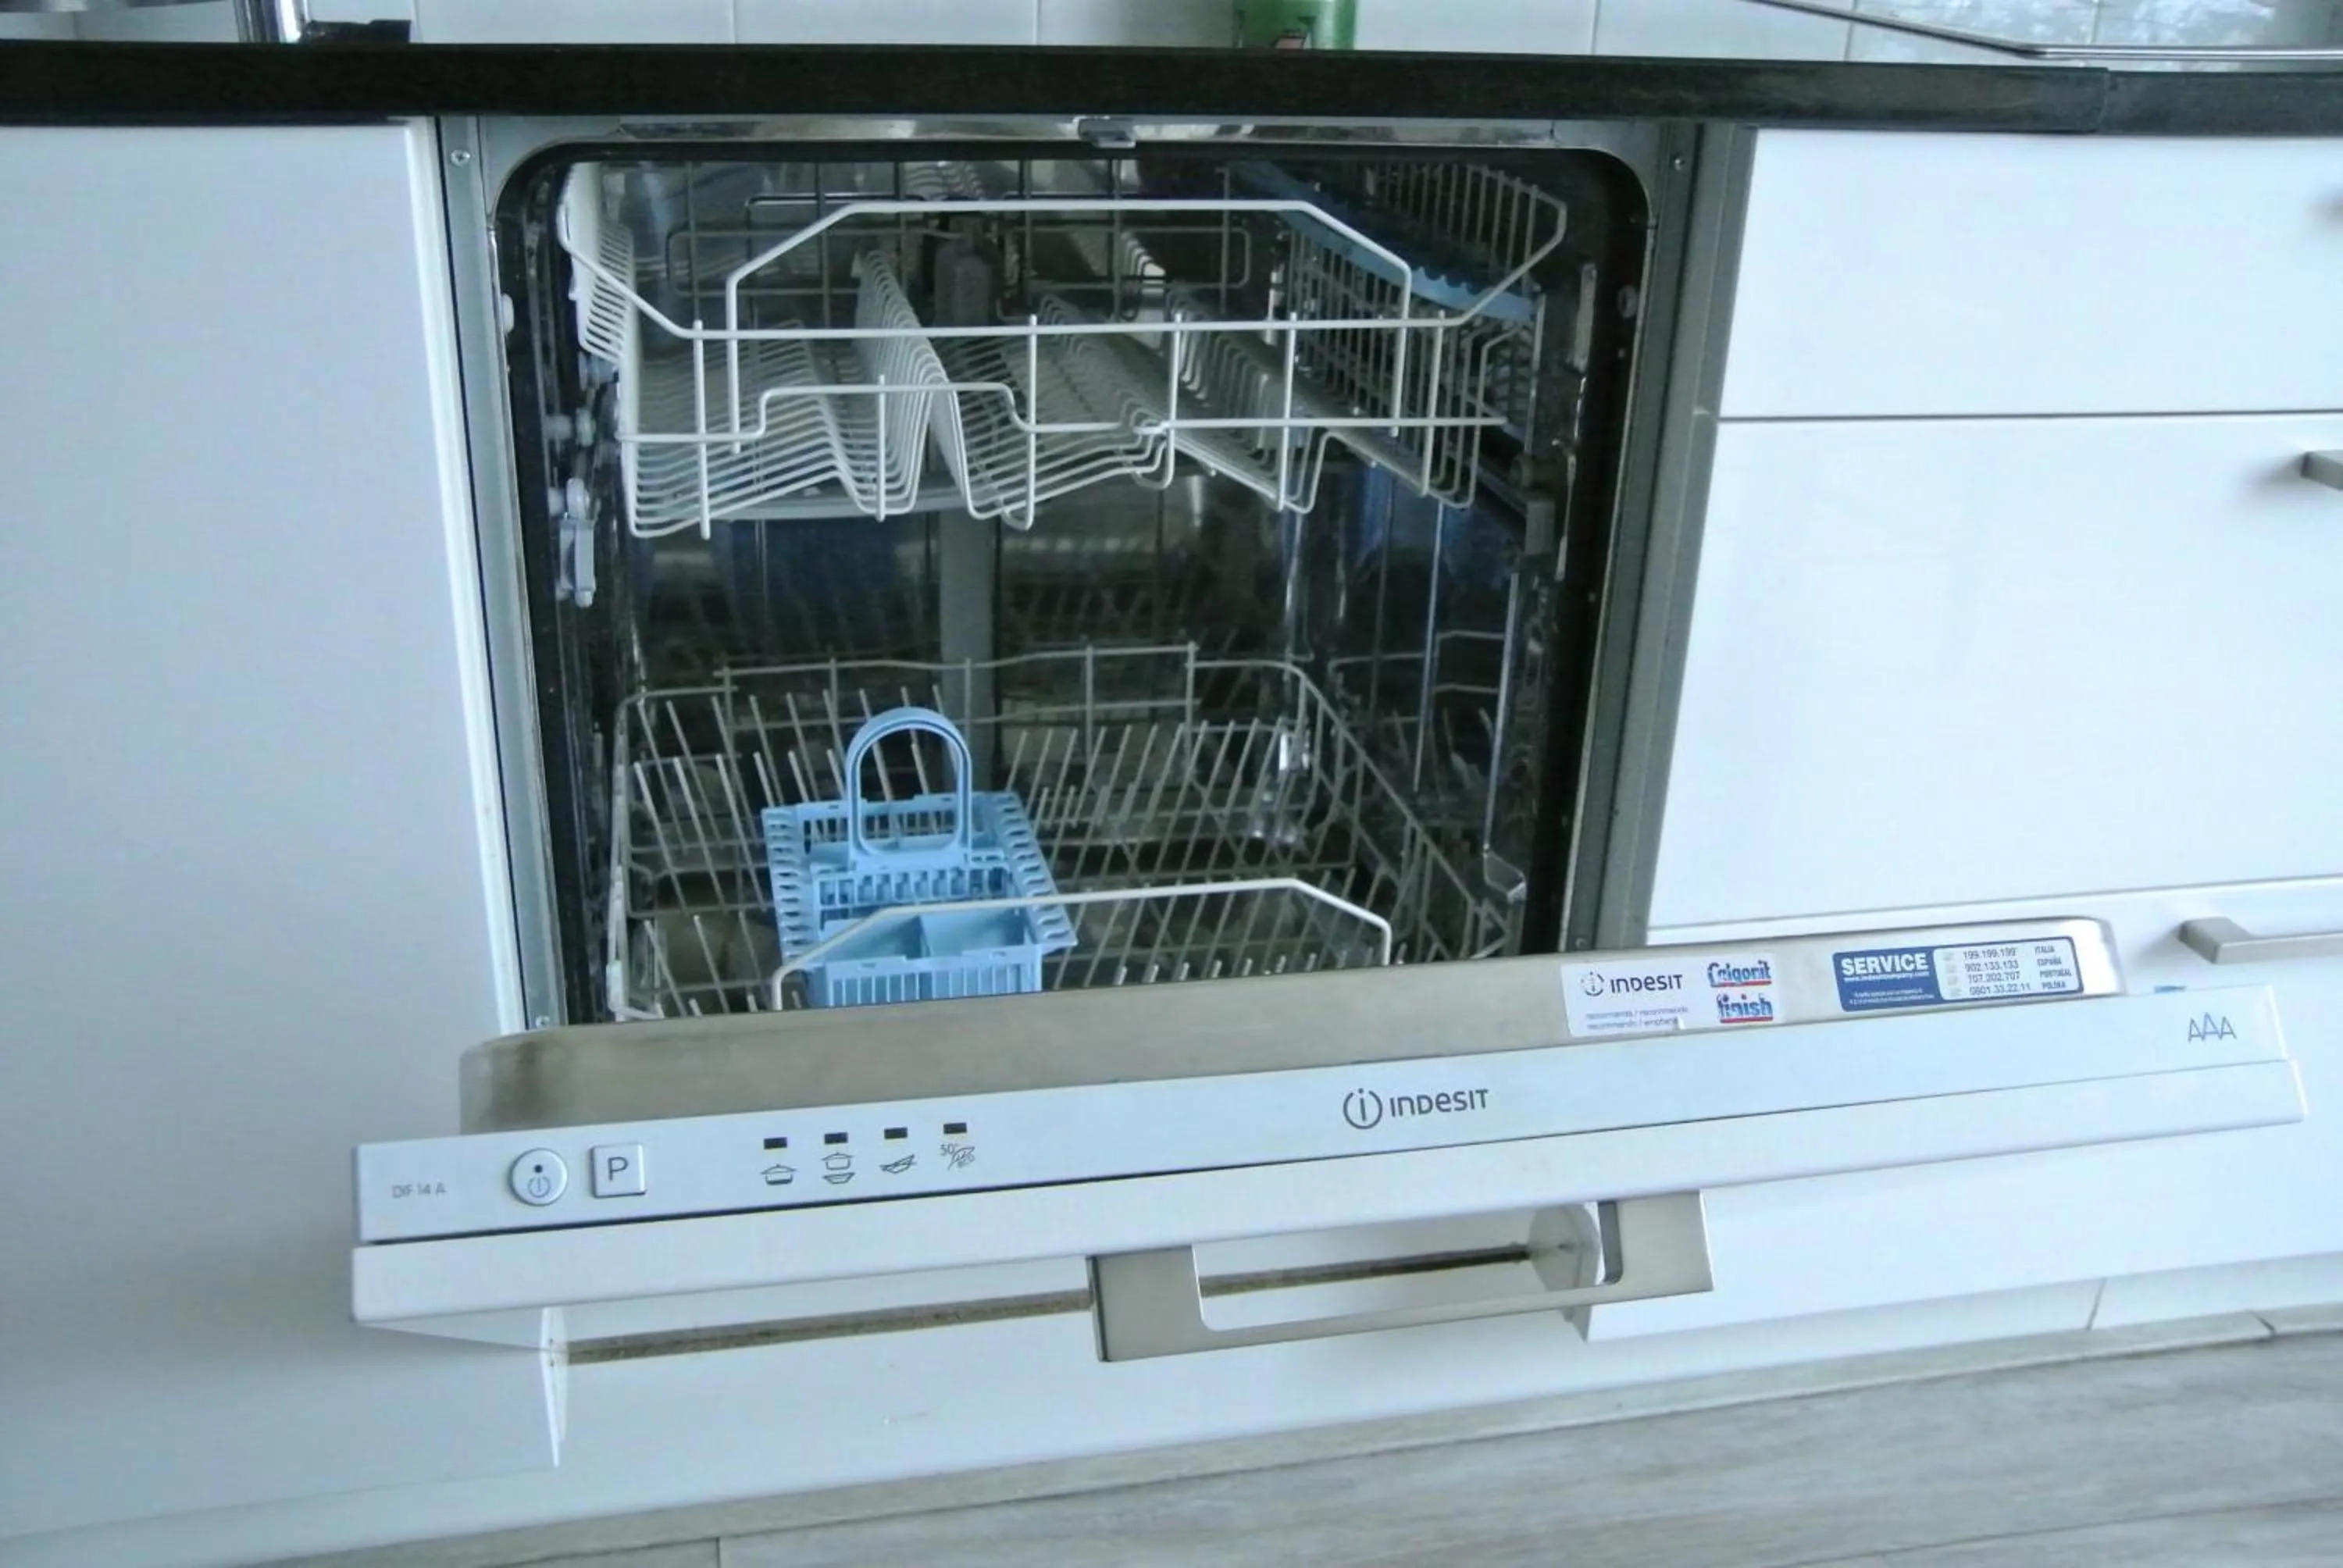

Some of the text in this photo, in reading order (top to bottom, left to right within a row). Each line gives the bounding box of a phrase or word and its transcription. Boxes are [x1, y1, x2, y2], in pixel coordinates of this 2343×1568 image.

[1841, 953, 1929, 976] SERVICE
[1610, 974, 1683, 994] INDESIT
[1716, 992, 1772, 1017] finish
[2188, 1012, 2238, 1043] AAA
[1389, 1089, 1489, 1117] INDESIT
[607, 1156, 629, 1181] P
[435, 1181, 448, 1196] A
